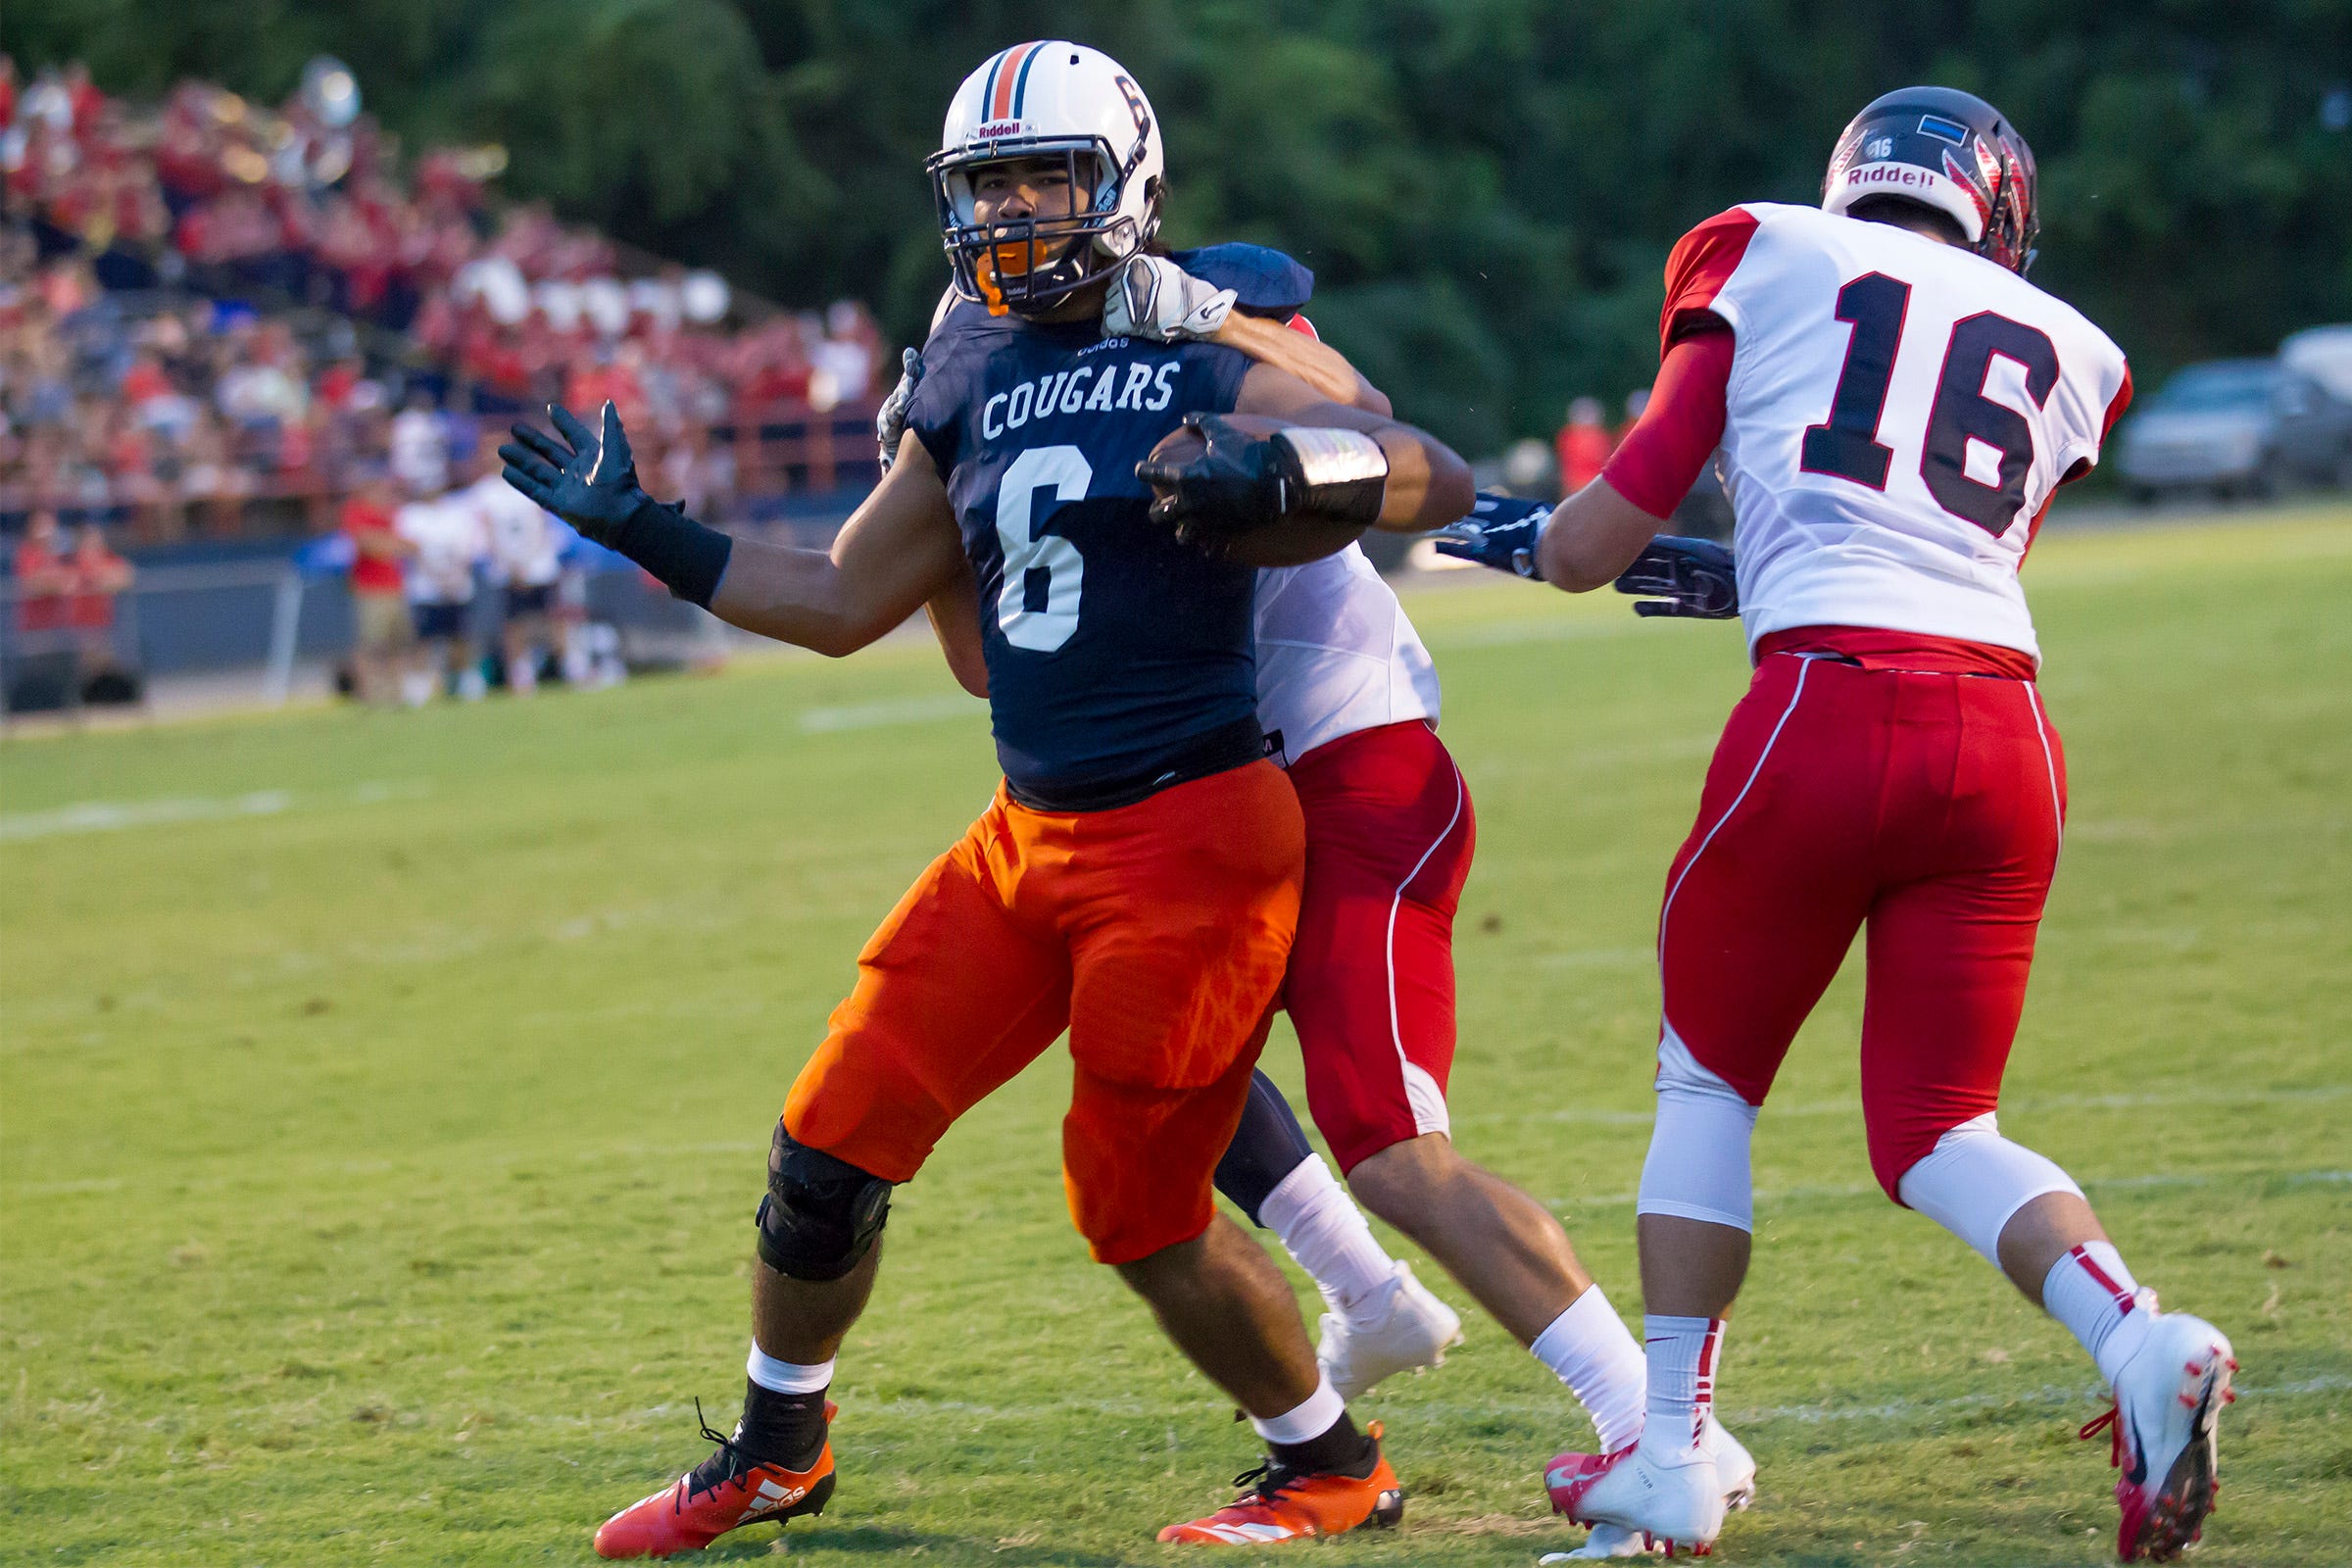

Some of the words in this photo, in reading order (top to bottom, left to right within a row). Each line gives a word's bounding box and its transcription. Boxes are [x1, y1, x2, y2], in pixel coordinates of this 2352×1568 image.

[979, 122, 1020, 138] Riddell
[1113, 75, 1149, 131] 6
[1847, 166, 1935, 188] Riddell
[983, 361, 1180, 440] COUGARS
[1800, 270, 2059, 539] 16
[996, 445, 1093, 652] 6
